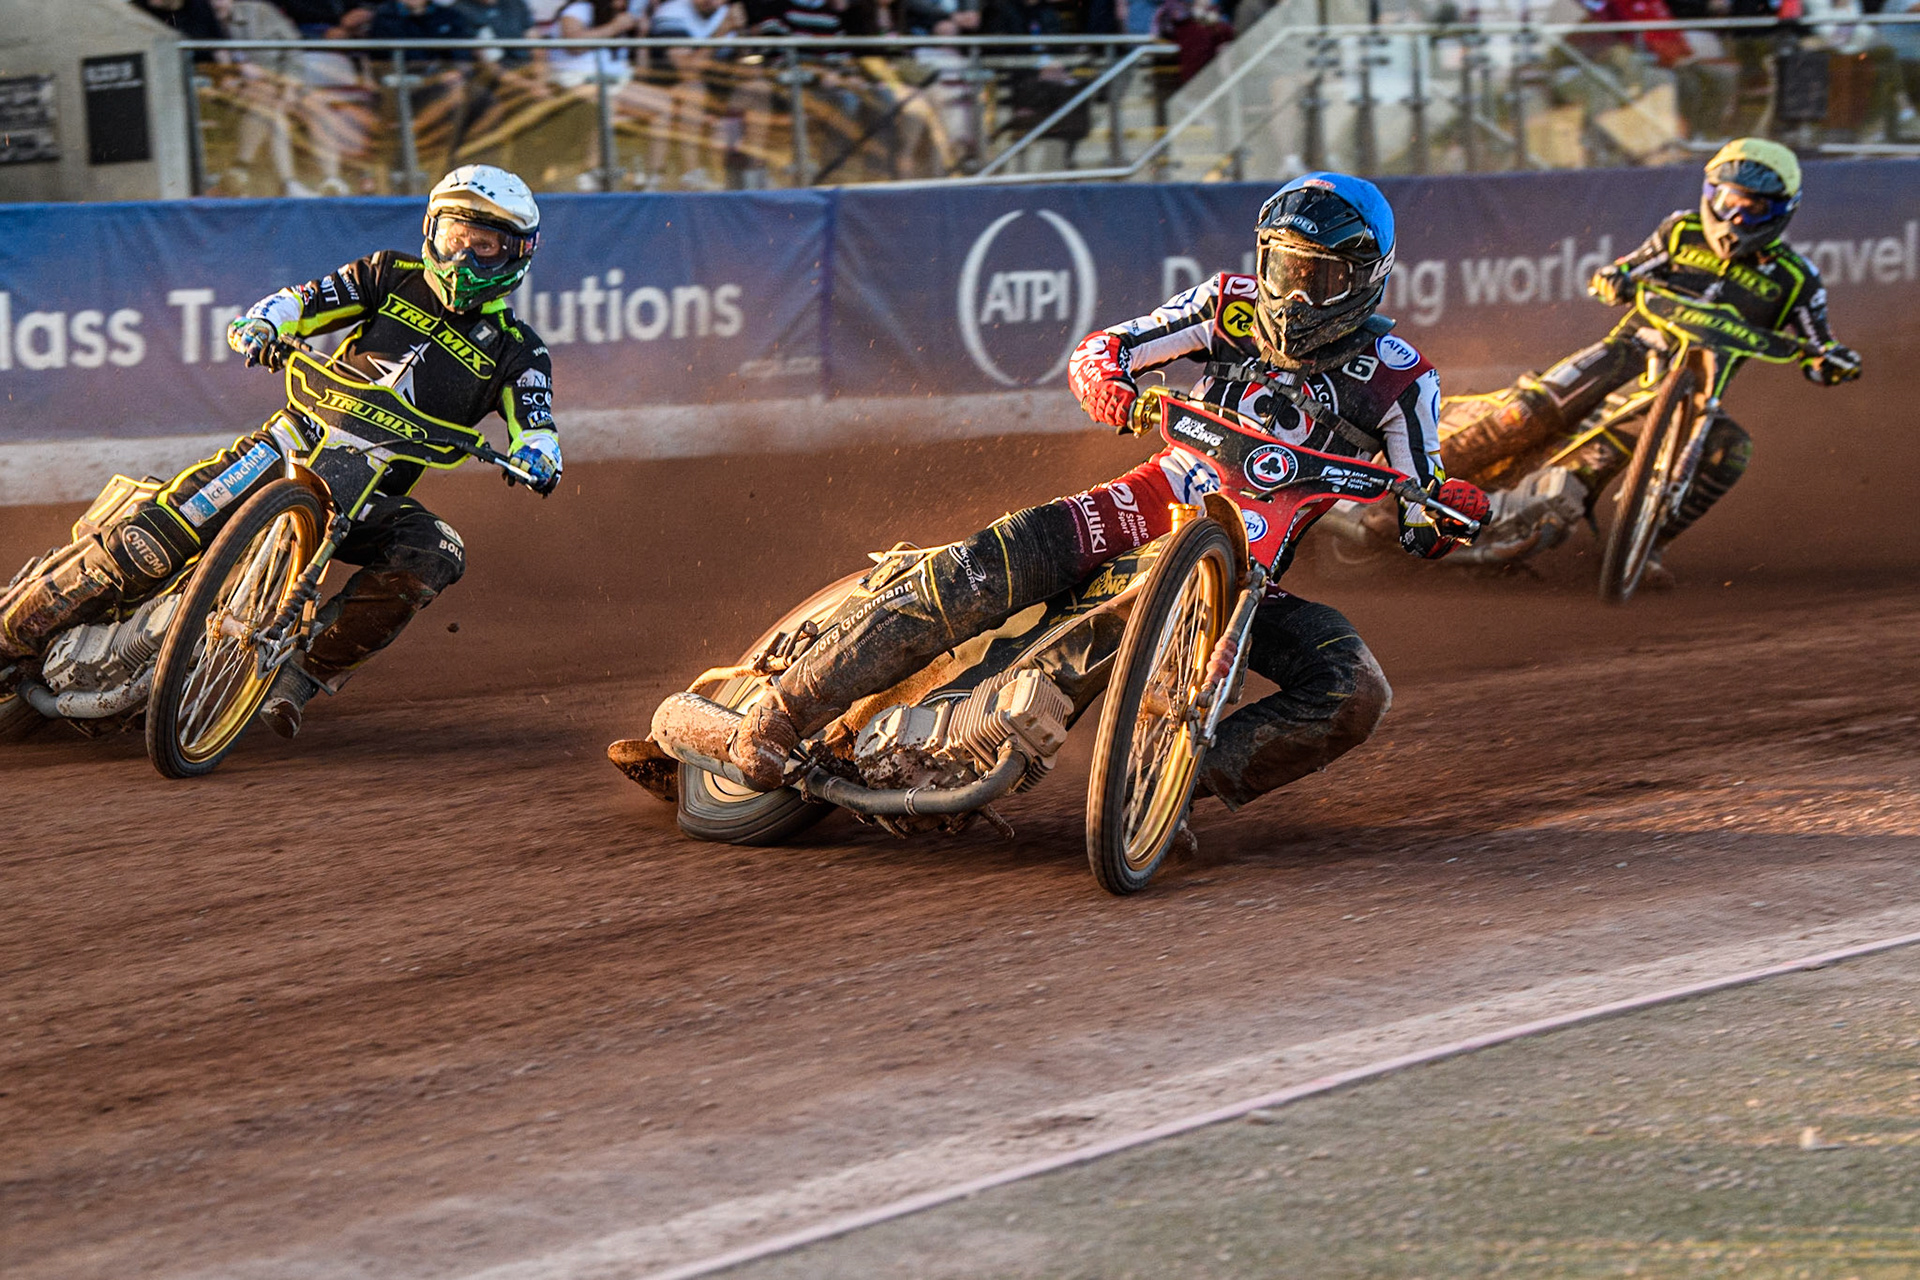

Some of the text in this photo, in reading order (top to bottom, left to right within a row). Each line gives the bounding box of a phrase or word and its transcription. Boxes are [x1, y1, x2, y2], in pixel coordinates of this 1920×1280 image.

[981, 270, 1070, 324] ATPI
[389, 301, 490, 372] TRU MIX
[1384, 339, 1412, 360] ATPI
[328, 394, 420, 438] TRU MIX
[207, 485, 225, 501] Ice
[223, 446, 268, 489] Machine
[1117, 511, 1131, 534] Sport
[1135, 514, 1150, 539] ADAC
[813, 580, 914, 657] Jörg Grohmann
